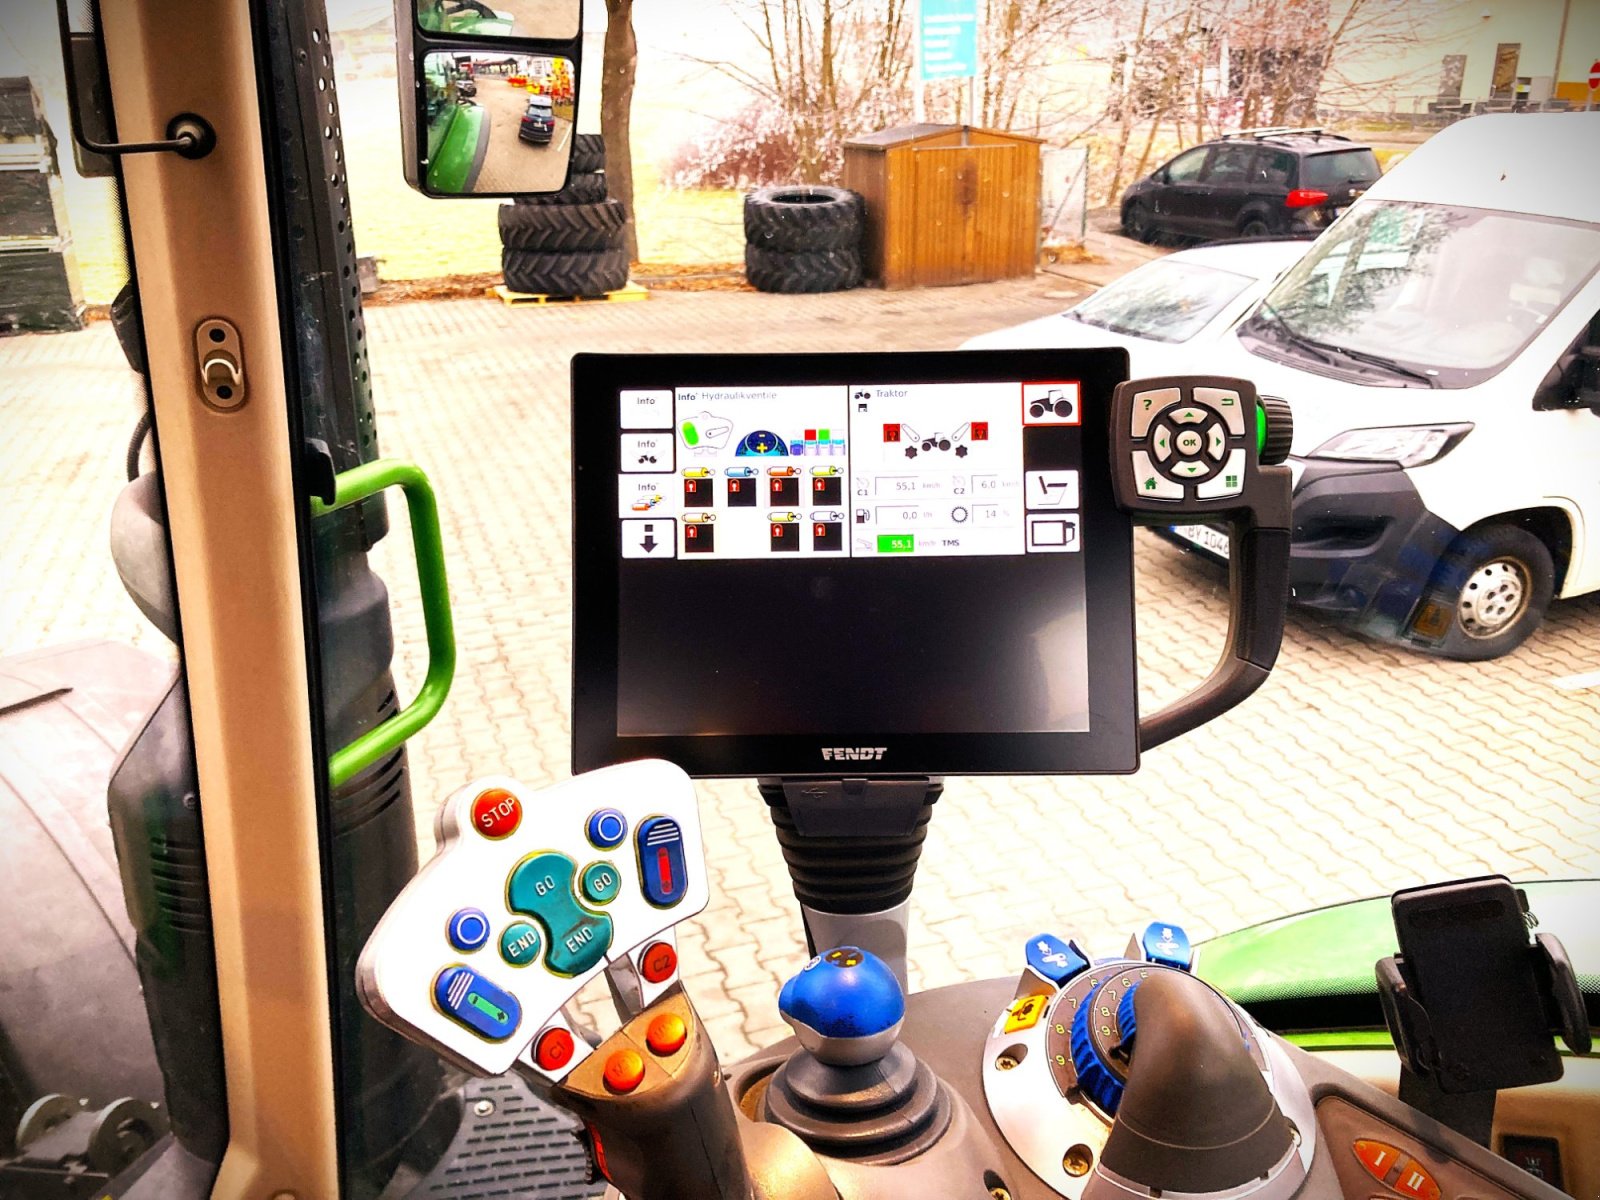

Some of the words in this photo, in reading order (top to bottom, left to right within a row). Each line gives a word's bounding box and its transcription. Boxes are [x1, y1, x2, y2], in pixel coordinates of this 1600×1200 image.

[876, 389, 908, 398] Traktor
[1183, 439, 1196, 447] OK
[896, 481, 916, 491] 55,1
[953, 487, 965, 495] C2
[902, 511, 918, 520] 0,0
[985, 509, 997, 518] 14
[891, 539, 912, 549] 55,1
[942, 539, 960, 547] TMS
[821, 747, 888, 761] FENDT
[481, 797, 516, 828] STOP
[535, 875, 556, 897] GO
[593, 872, 613, 892] GO
[507, 931, 538, 958] END
[565, 927, 594, 953] END
[652, 956, 671, 972] C2
[1122, 977, 1132, 988] 6
[1108, 990, 1117, 1001] 7
[1069, 998, 1078, 1009] 7
[1101, 1006, 1111, 1017] 8
[1055, 1023, 1065, 1034] 8
[1101, 1025, 1111, 1036] 9
[550, 1043, 567, 1060] C1
[1055, 1054, 1065, 1066] 9
